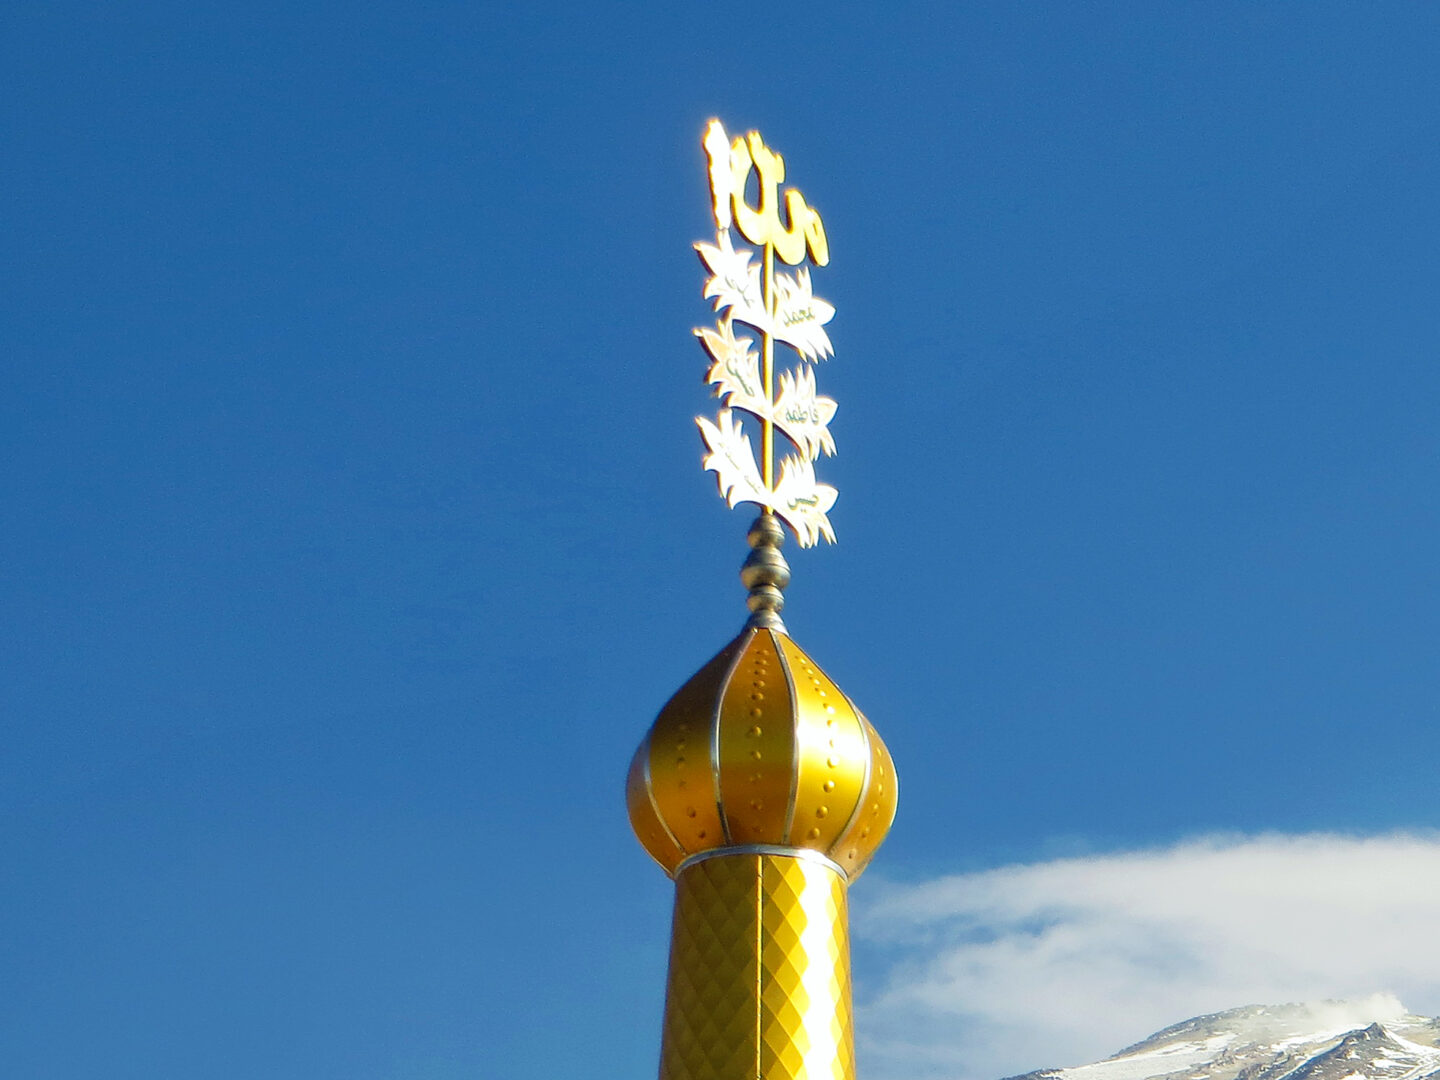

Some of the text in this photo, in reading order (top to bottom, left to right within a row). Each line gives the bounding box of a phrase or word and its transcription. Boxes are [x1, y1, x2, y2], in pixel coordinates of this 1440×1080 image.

[783, 306, 816, 328] محمد
[785, 402, 820, 427] فاطمه
[787, 493, 820, 514] حسین
